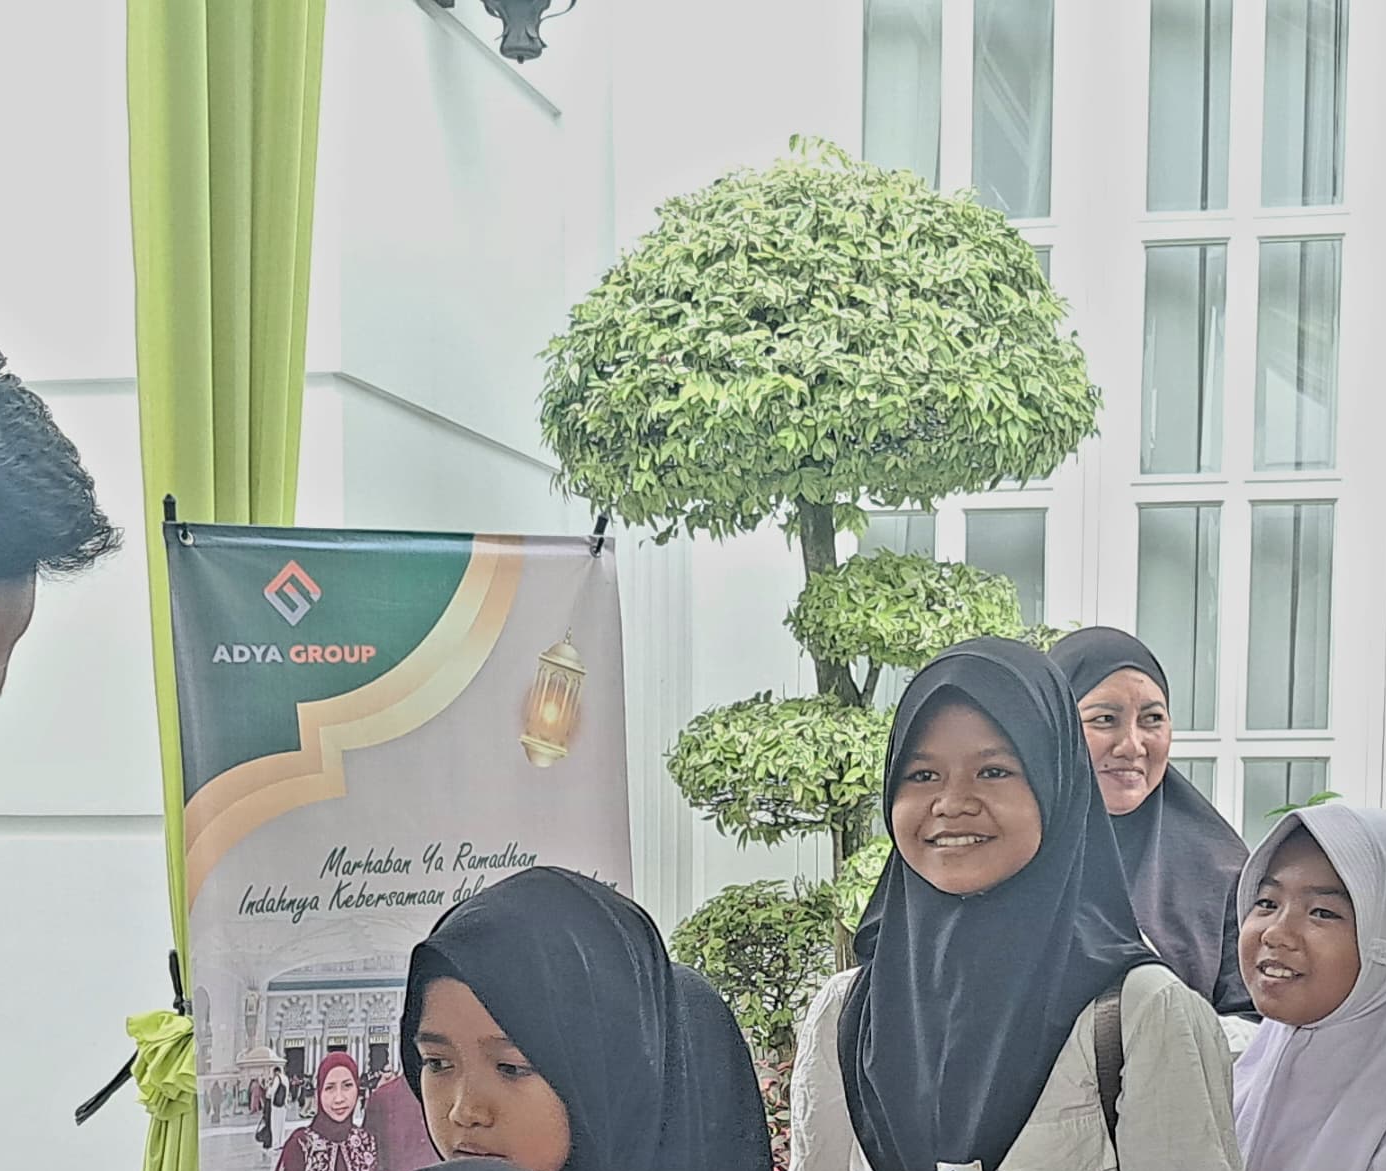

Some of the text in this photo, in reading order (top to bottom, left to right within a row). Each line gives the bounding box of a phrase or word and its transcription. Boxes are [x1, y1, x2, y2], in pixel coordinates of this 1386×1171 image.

[212, 644, 377, 664] ADYA GROUP
[319, 841, 538, 879] Marhaban Ya Ramadhan
[238, 885, 319, 924] Indahnya
[328, 880, 445, 911] Kebersamaan
